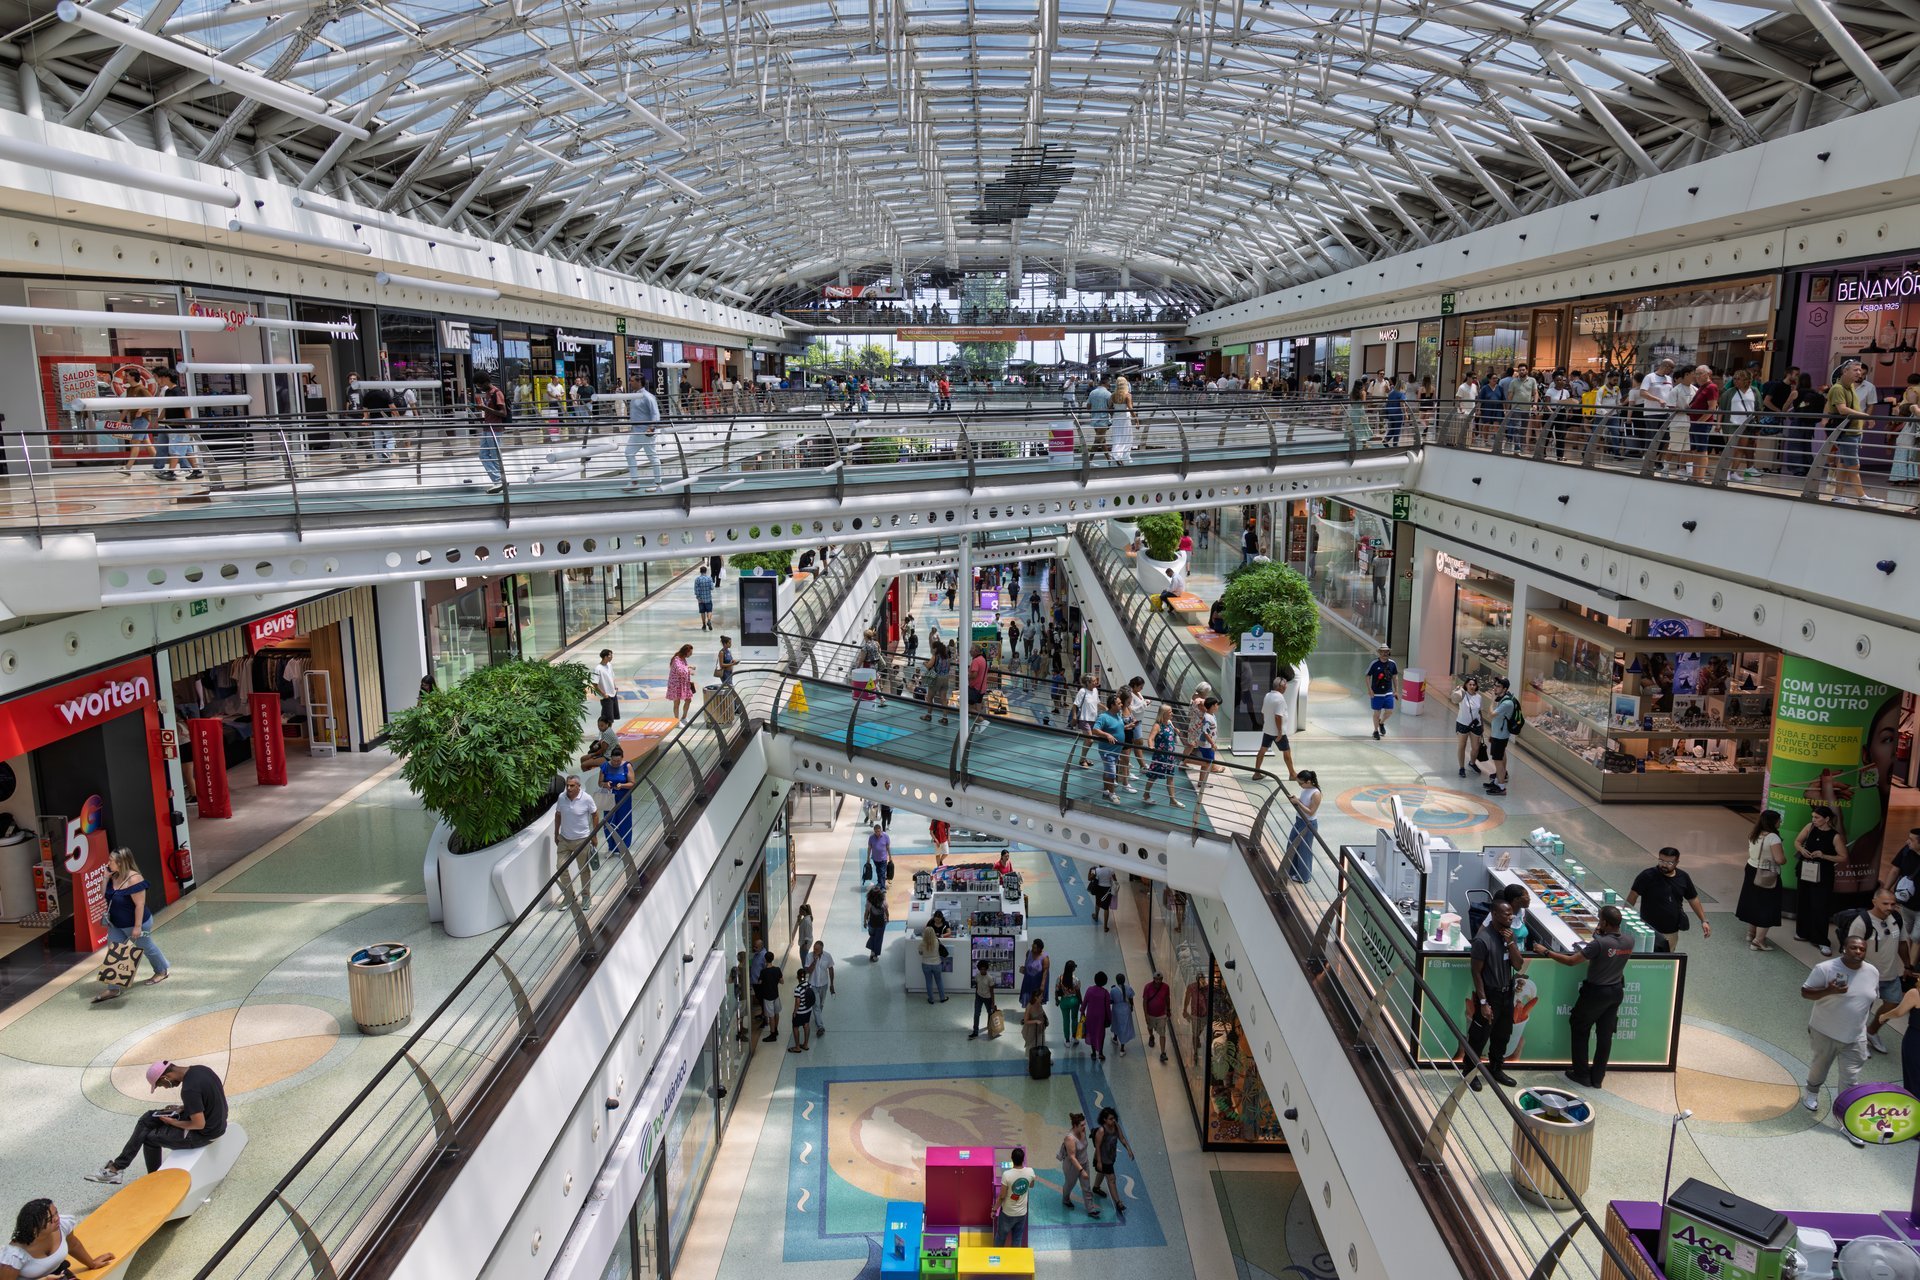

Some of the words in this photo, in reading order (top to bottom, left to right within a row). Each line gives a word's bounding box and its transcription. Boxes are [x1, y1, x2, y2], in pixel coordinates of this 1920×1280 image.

[1859, 304, 1883, 313] LISBOA
[1884, 303, 1900, 312] 1925
[440, 320, 471, 350] VANS
[1379, 328, 1399, 341] MANGO
[62, 368, 95, 382] SALDOS
[63, 380, 96, 393] SALDOS
[1783, 678, 1814, 694] COM
[1818, 683, 1861, 696] VISTA
[1864, 684, 1888, 696] RIO
[60, 676, 150, 725] worten
[1781, 691, 1810, 706] TEM
[1814, 697, 1869, 710] OUTRO
[1780, 705, 1830, 722] SABOR
[261, 704, 273, 771] PROMOÇÕES
[1777, 728, 1798, 740] SUBA
[1808, 733, 1858, 744] DESCUBRA
[1776, 744, 1787, 752] NO
[1788, 746, 1811, 756] PISO
[1783, 738, 1809, 748] RIVER
[1811, 740, 1837, 751] DECK
[1770, 791, 1829, 807] EXPERIMENTE
[1830, 799, 1852, 808] MAIS
[64, 794, 103, 873] 5G
[84, 872, 89, 881] A
